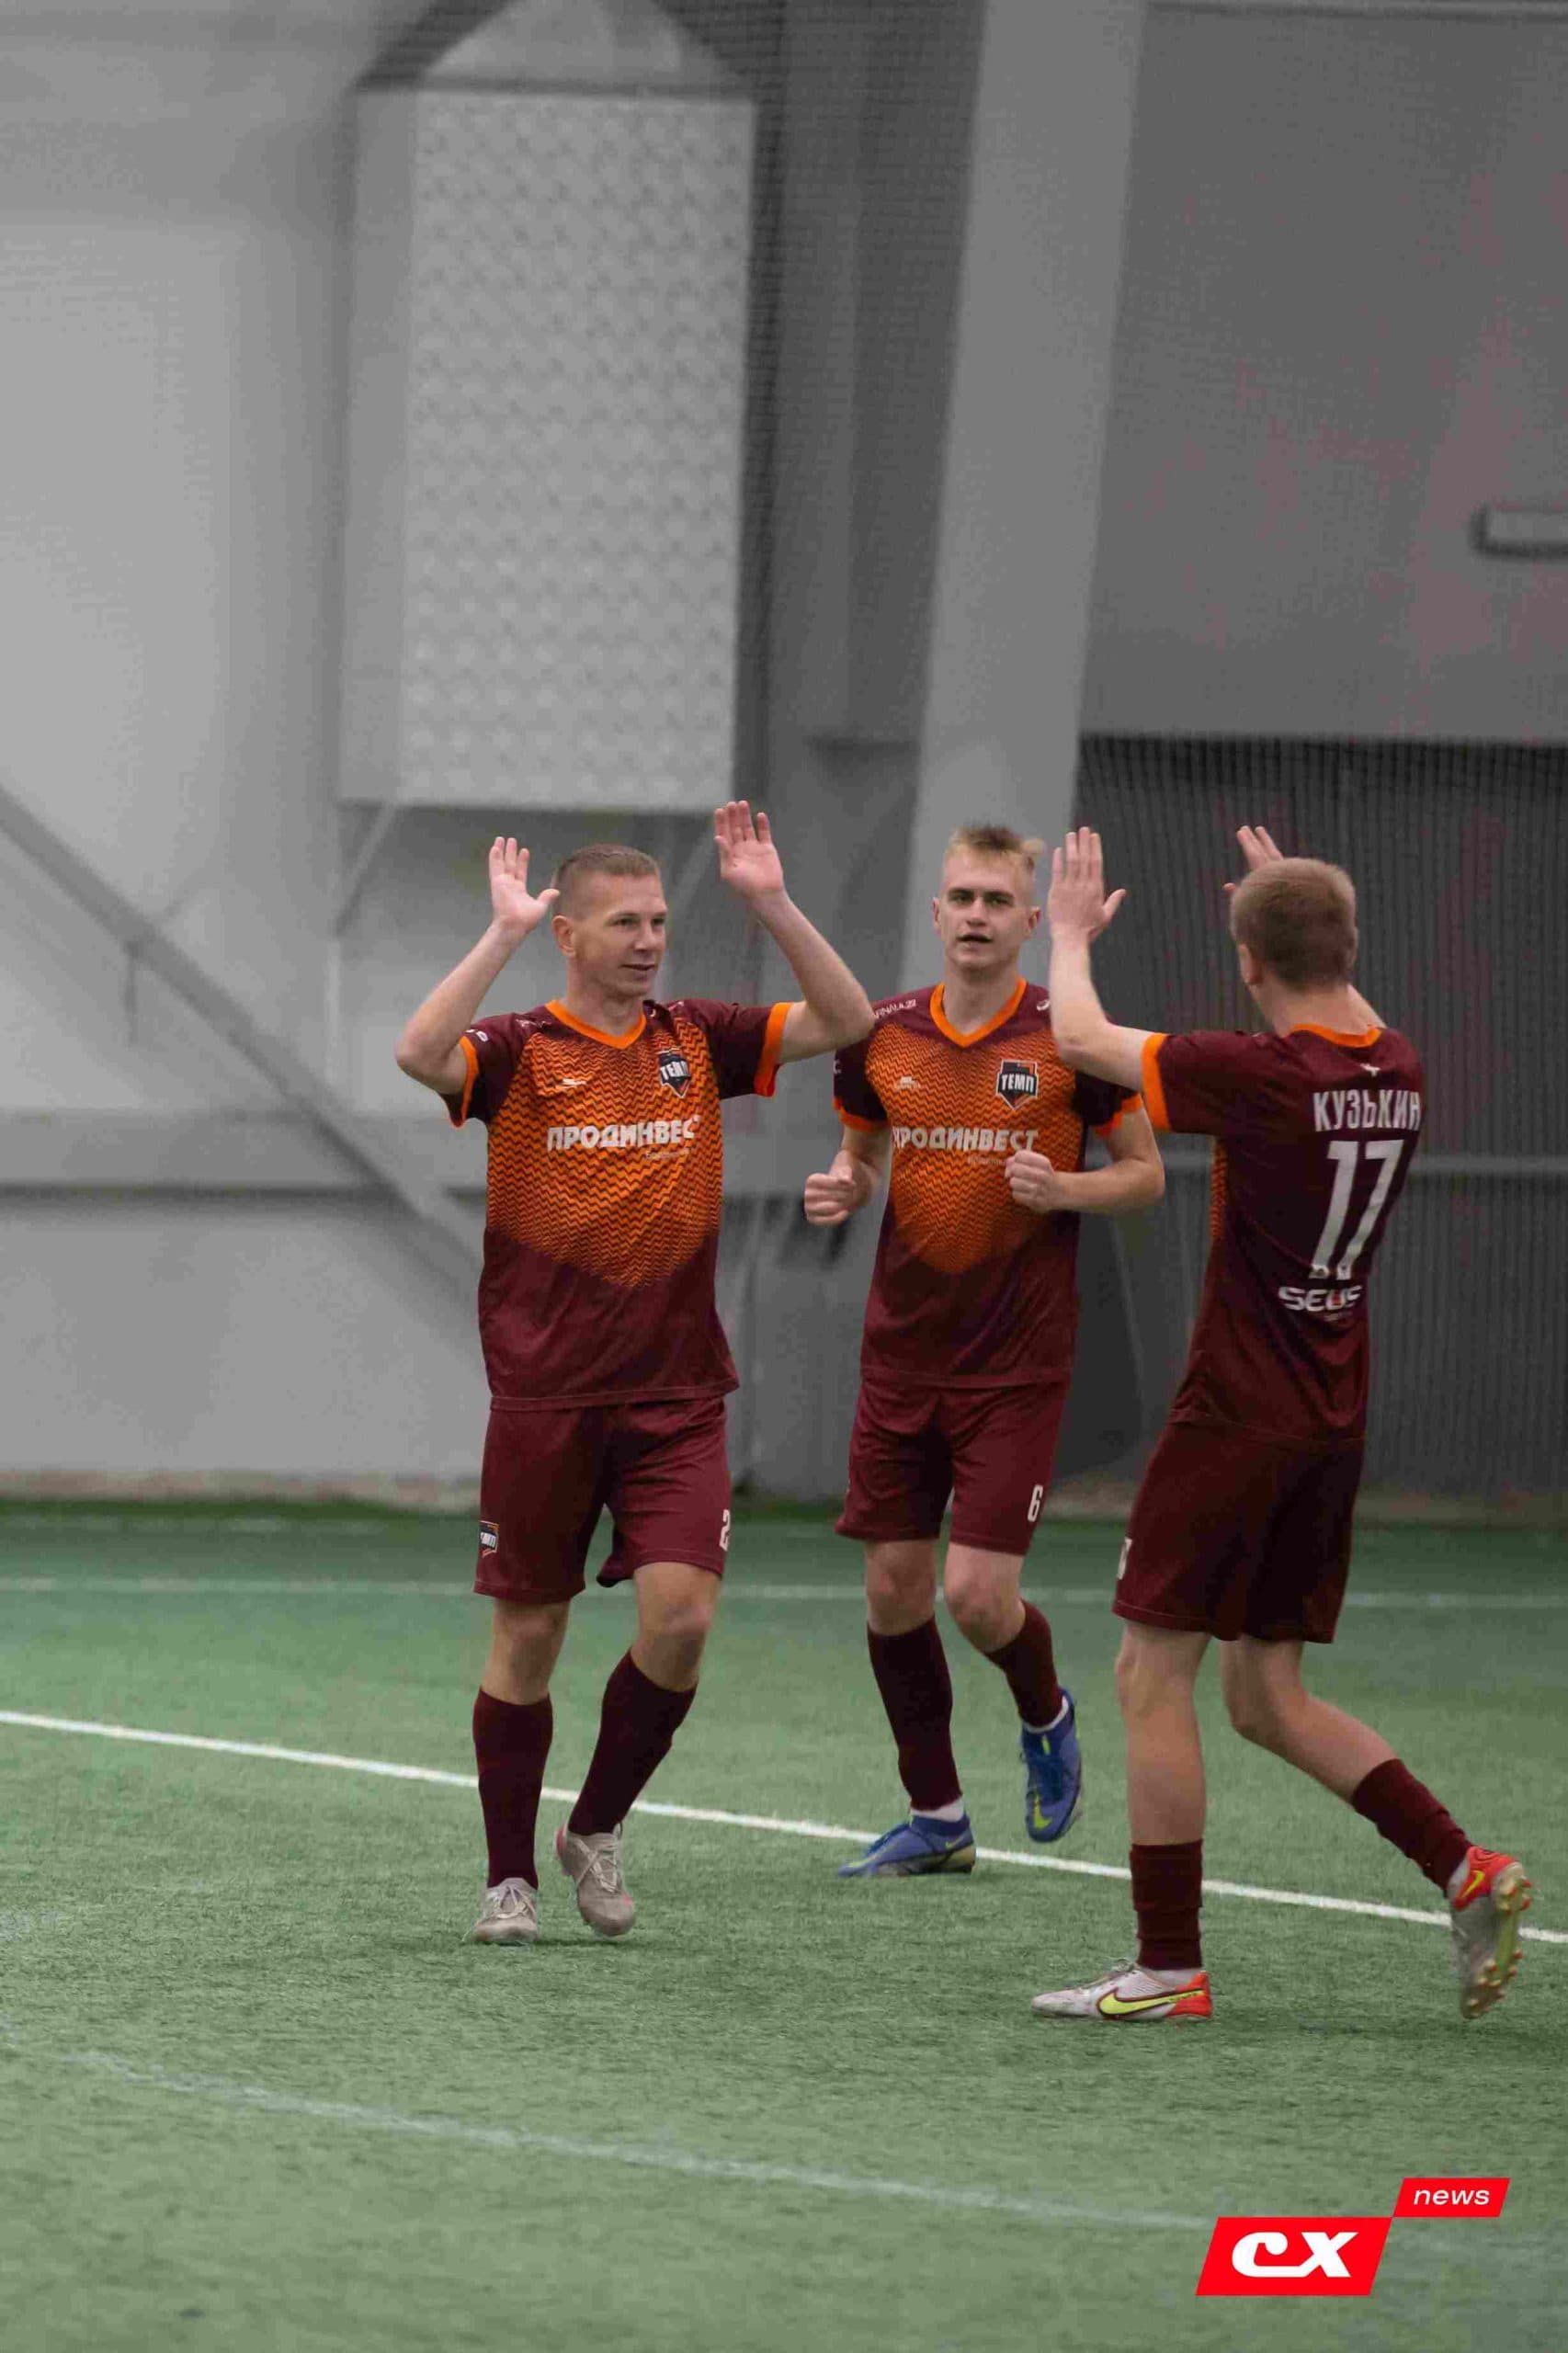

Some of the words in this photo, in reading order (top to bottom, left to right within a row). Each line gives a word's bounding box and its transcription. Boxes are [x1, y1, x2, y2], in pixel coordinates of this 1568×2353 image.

[1002, 1074, 1035, 1093] ТЕМП
[1312, 1089, 1422, 1132] КУЗЬКИН
[1308, 1140, 1404, 1280] 17
[1027, 1484, 1044, 1522] 6
